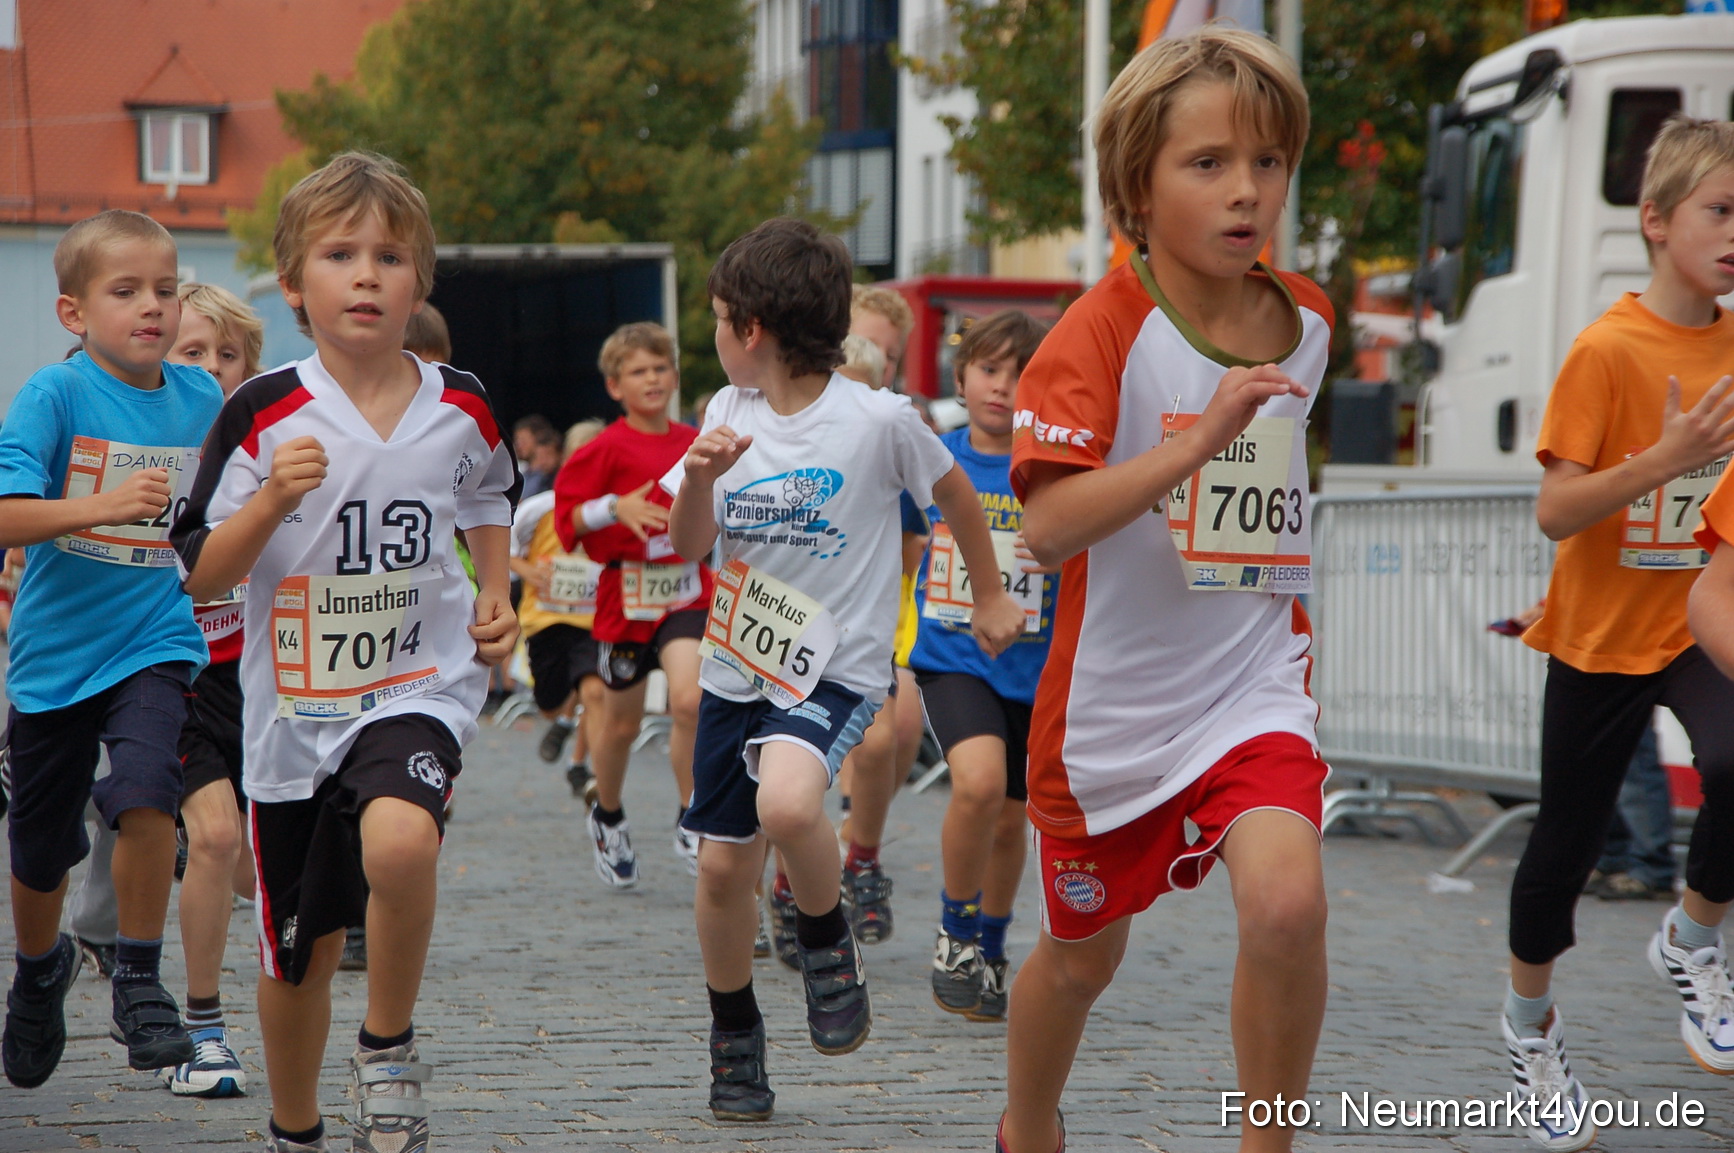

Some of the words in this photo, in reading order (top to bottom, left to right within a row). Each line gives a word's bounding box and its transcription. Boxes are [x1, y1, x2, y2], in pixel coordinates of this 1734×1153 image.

[726, 501, 821, 524] Paniersplatz
[1210, 484, 1303, 535] 7063
[336, 499, 433, 576] 13
[790, 535, 818, 548] Sport
[1261, 567, 1311, 581] PFLEIDERER
[647, 577, 692, 597] 7041
[317, 584, 419, 614] Jonathan
[715, 594, 729, 615] K4
[746, 578, 807, 626] Markus
[203, 609, 239, 633] DEHN
[277, 629, 299, 650] K4
[321, 620, 422, 672] 7014
[739, 612, 816, 677] 7015
[293, 700, 338, 715] BOCK
[1064, 874, 1102, 892] BAYERN
